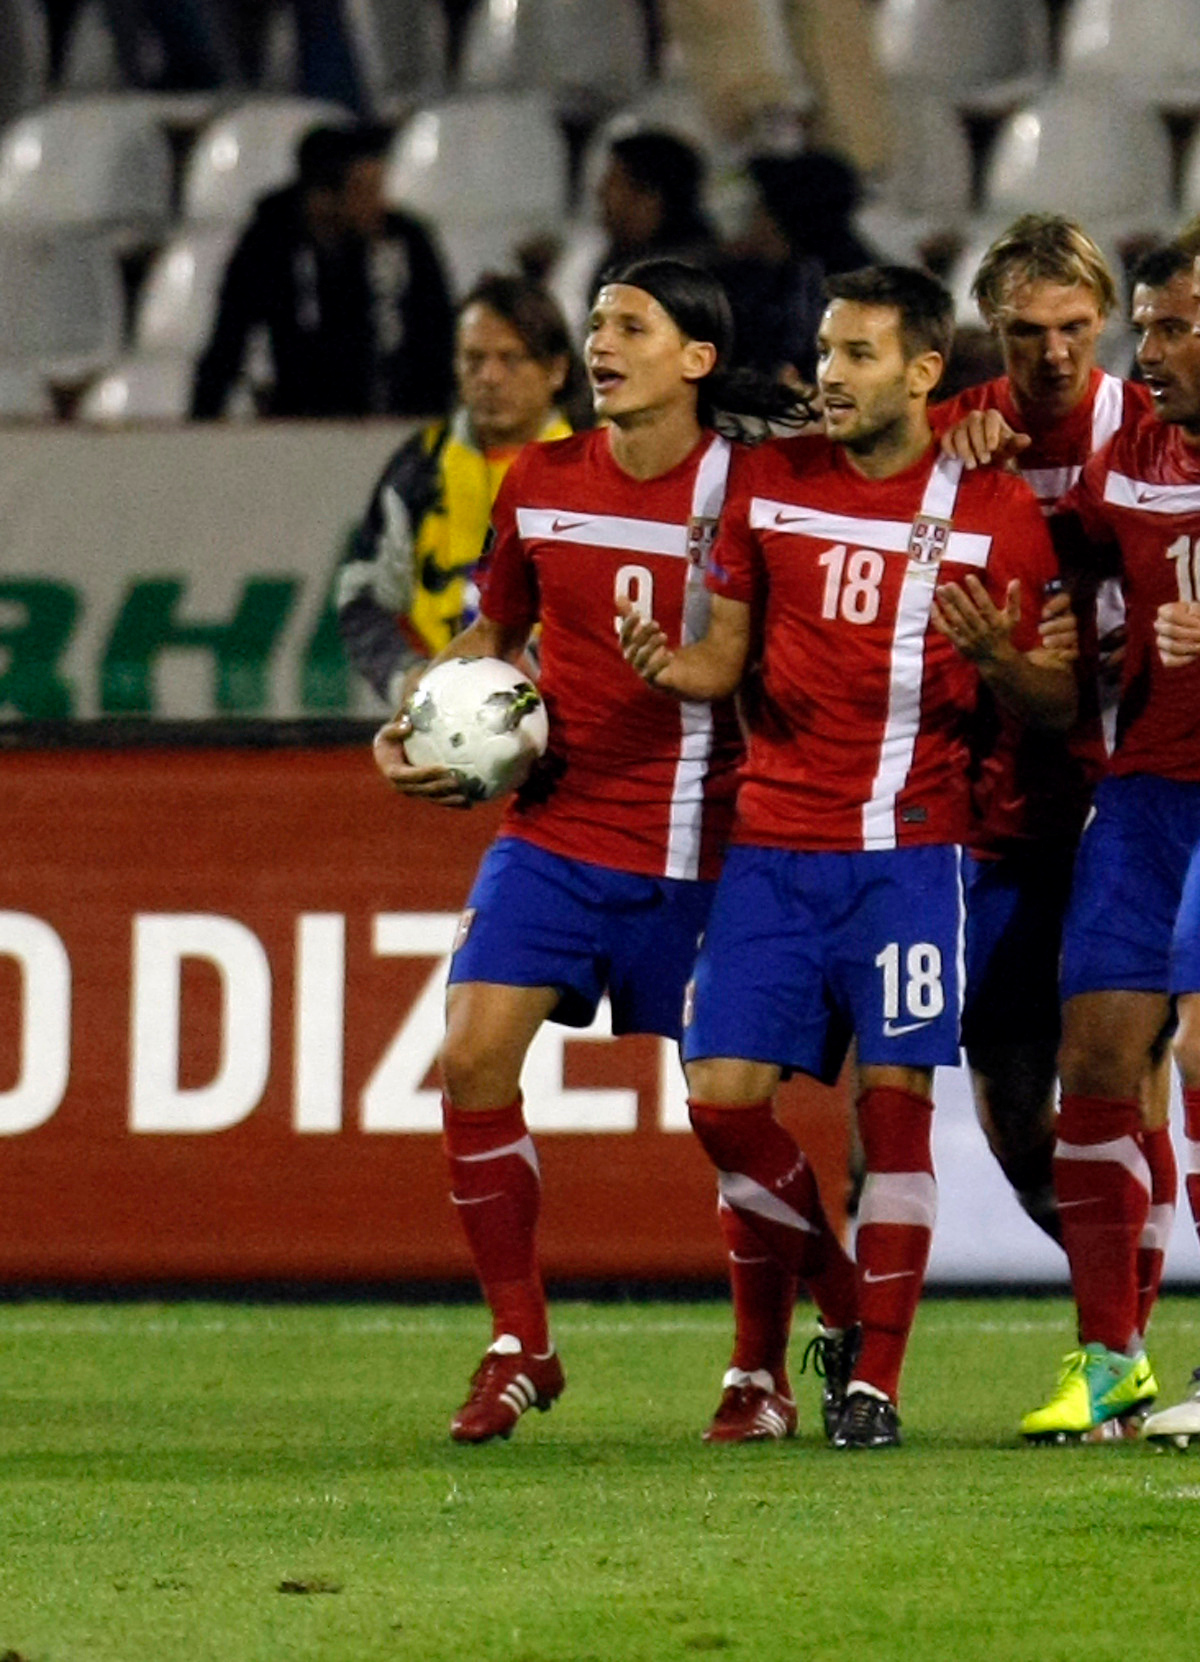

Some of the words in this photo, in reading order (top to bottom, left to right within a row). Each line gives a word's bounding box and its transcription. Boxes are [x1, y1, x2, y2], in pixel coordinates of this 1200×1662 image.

[614, 564, 653, 634] 9
[818, 545, 885, 625] 18
[875, 942, 945, 1019] 18
[128, 912, 697, 1134] DIZE
